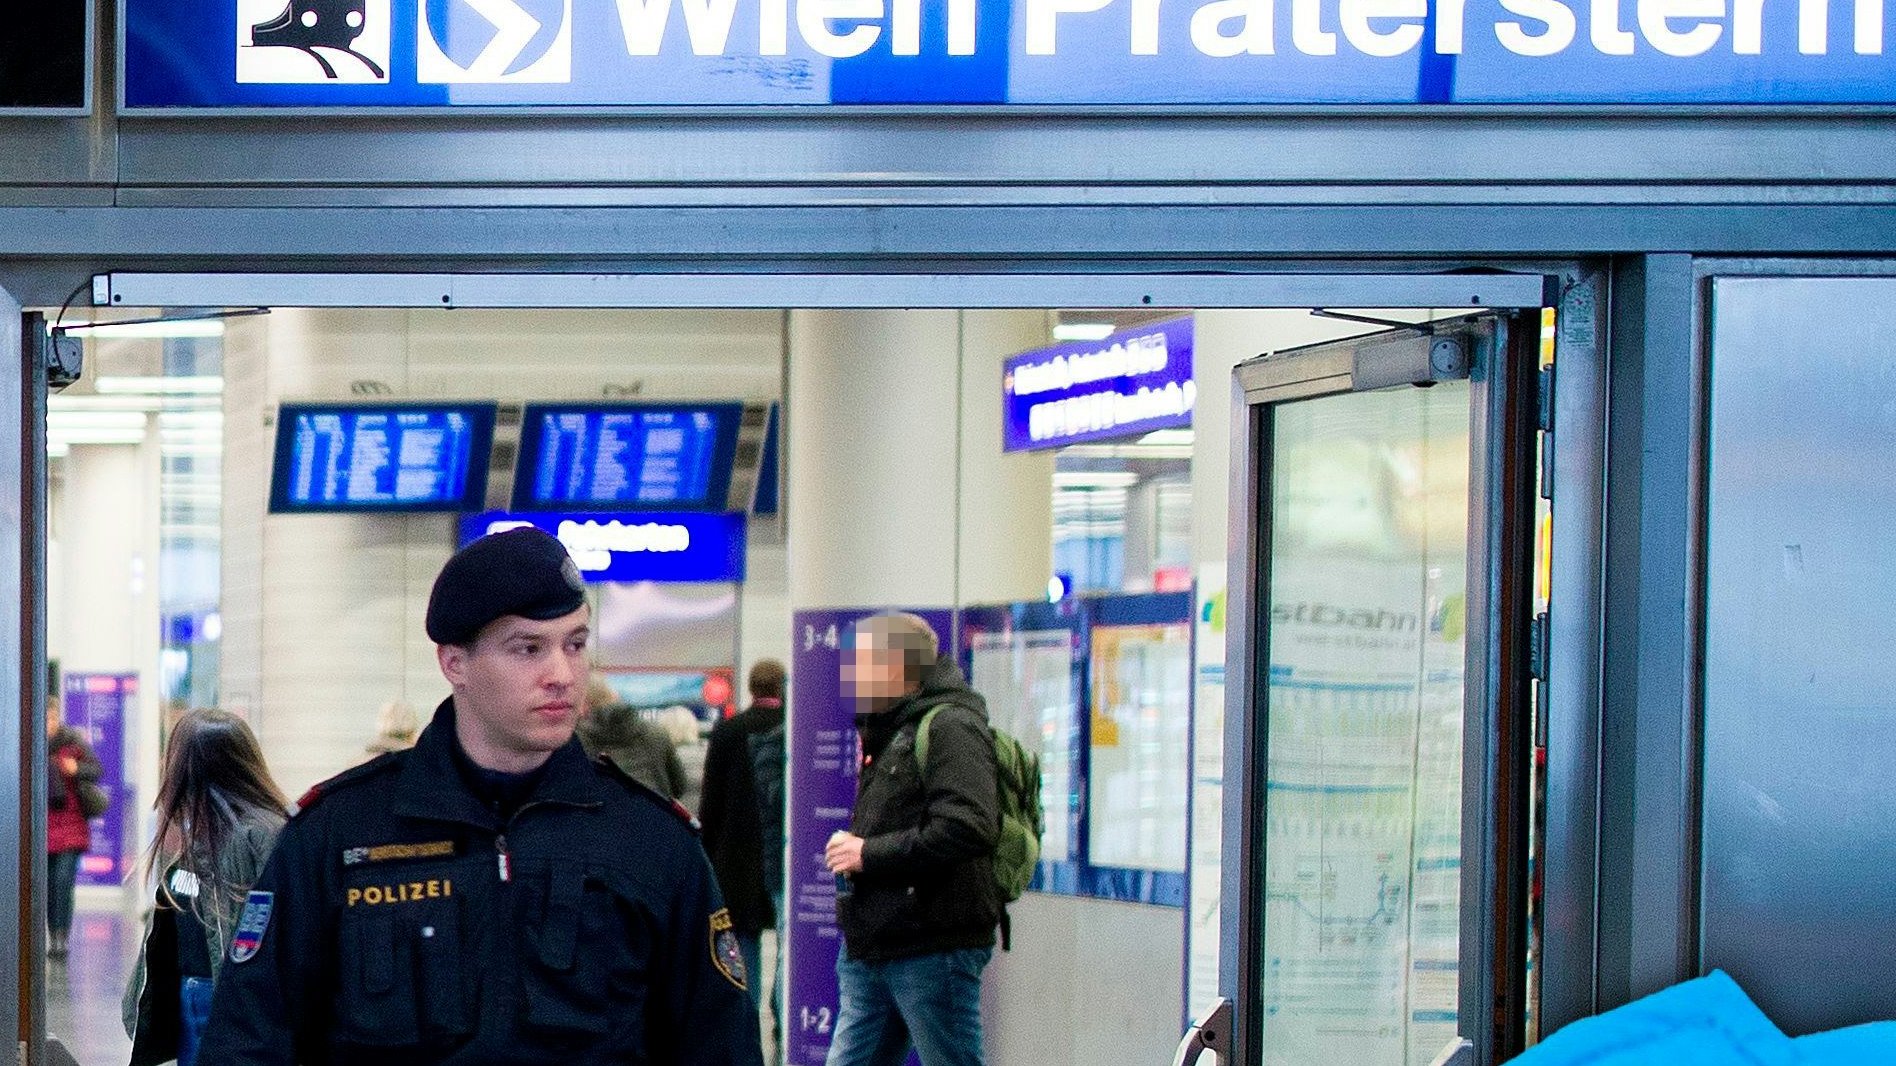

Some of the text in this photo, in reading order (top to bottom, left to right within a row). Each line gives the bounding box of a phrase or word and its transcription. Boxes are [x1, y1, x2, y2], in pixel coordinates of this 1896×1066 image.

[615, 0, 1883, 58] Wien Praterstern
[346, 879, 452, 907] POLIZEI
